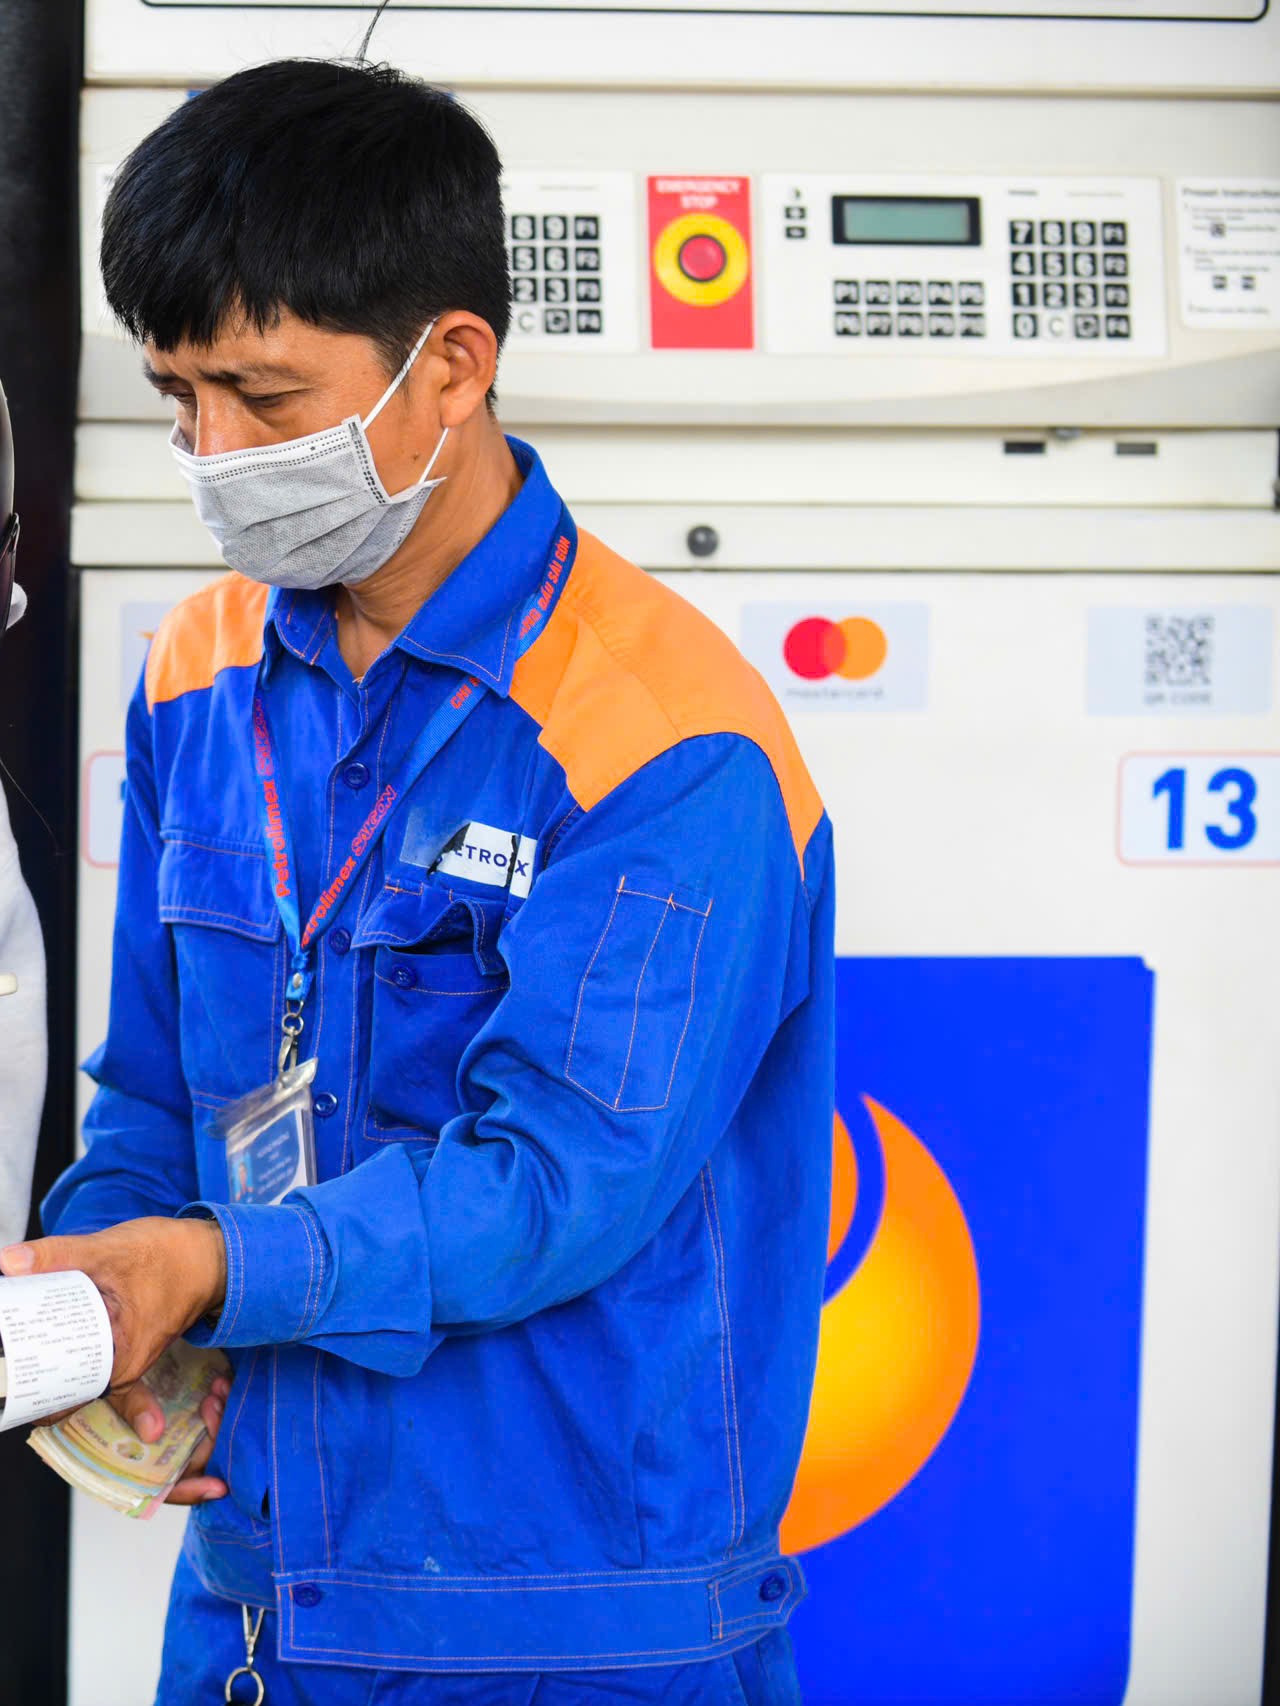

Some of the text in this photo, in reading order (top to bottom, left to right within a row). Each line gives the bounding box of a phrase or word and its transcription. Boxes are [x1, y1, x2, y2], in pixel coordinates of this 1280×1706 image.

[681, 195, 718, 209] STOP
[515, 216, 533, 240] 8
[546, 216, 565, 240] 9
[1013, 222, 1031, 244] 7
[1044, 222, 1061, 245] 8
[1074, 222, 1092, 245] 9
[516, 248, 533, 271] 5
[546, 248, 565, 271] 6
[1014, 252, 1031, 275] 4
[1045, 252, 1062, 276] 5
[1075, 253, 1094, 276] 6
[516, 278, 534, 302] 2
[547, 278, 566, 302] 3
[1046, 284, 1064, 307] 2
[1077, 284, 1095, 307] 3
[1152, 766, 1258, 850] 13
